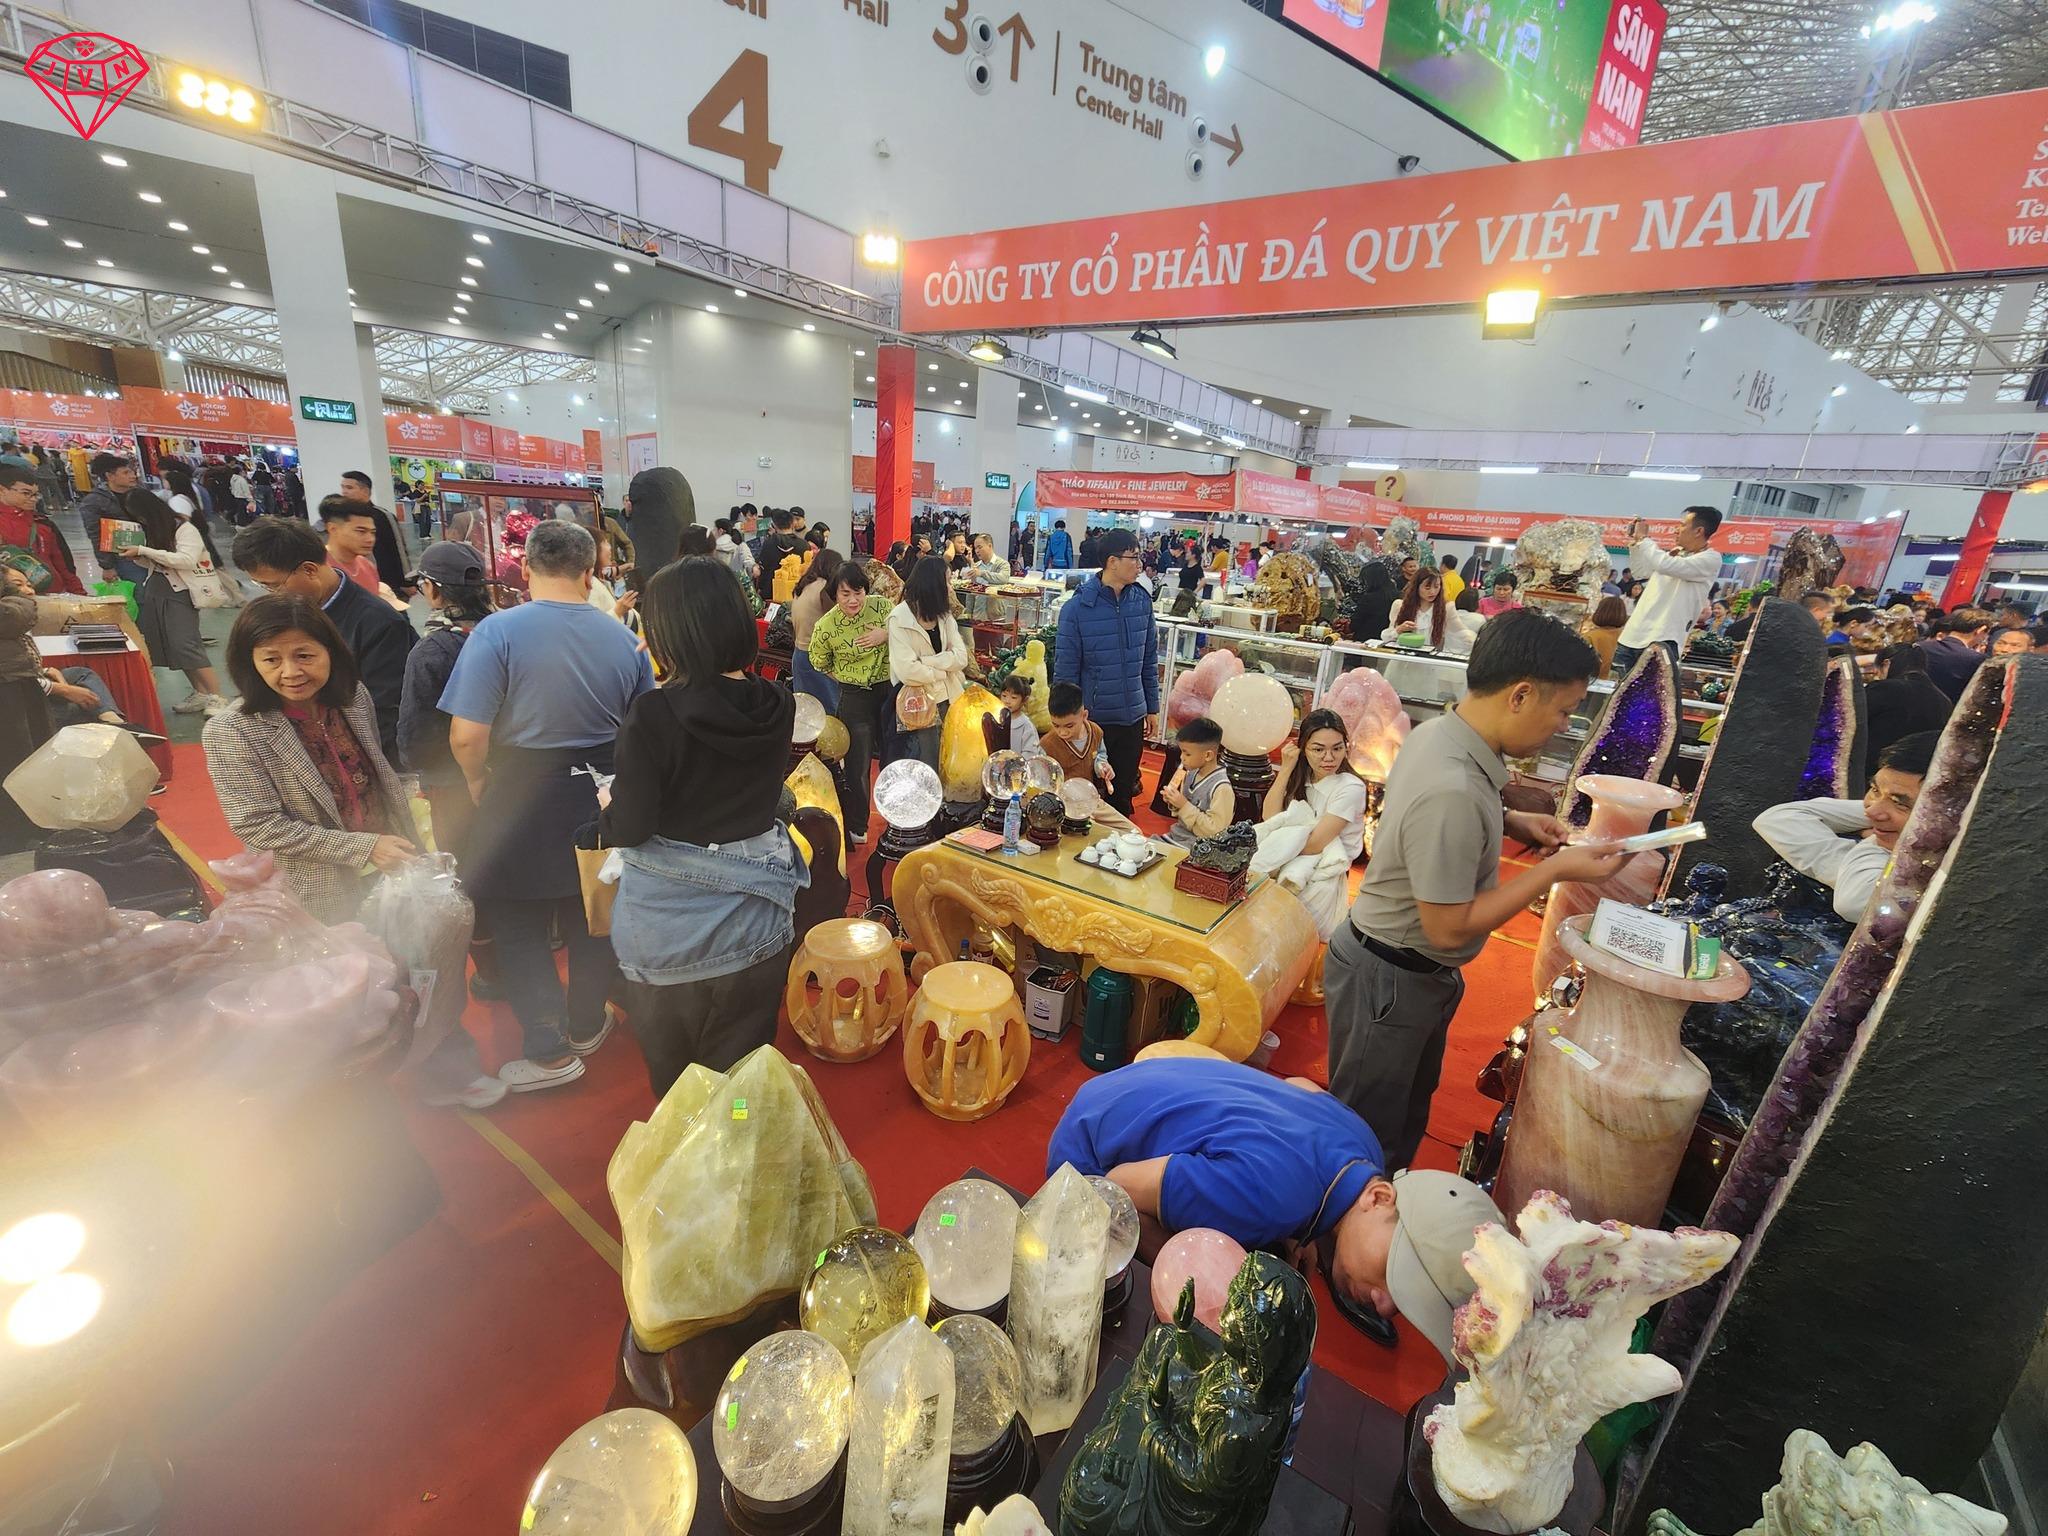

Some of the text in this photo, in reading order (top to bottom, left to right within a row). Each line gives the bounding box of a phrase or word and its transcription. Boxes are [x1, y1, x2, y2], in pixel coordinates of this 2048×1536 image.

[1613, 4, 1655, 72] SÂN
[1076, 85, 1163, 140] Center Hall
[1080, 41, 1187, 118] Trung tâm
[1597, 60, 1643, 130] NAM
[687, 48, 783, 195] 4
[924, 181, 1825, 307] CÔNG TY CỔ PHẦN ĐÁ QUÝ VIỆT NAM
[1087, 479, 1120, 490] TIFFANY
[1127, 481, 1147, 491] FINE
[1149, 481, 1188, 492] JEWELRY
